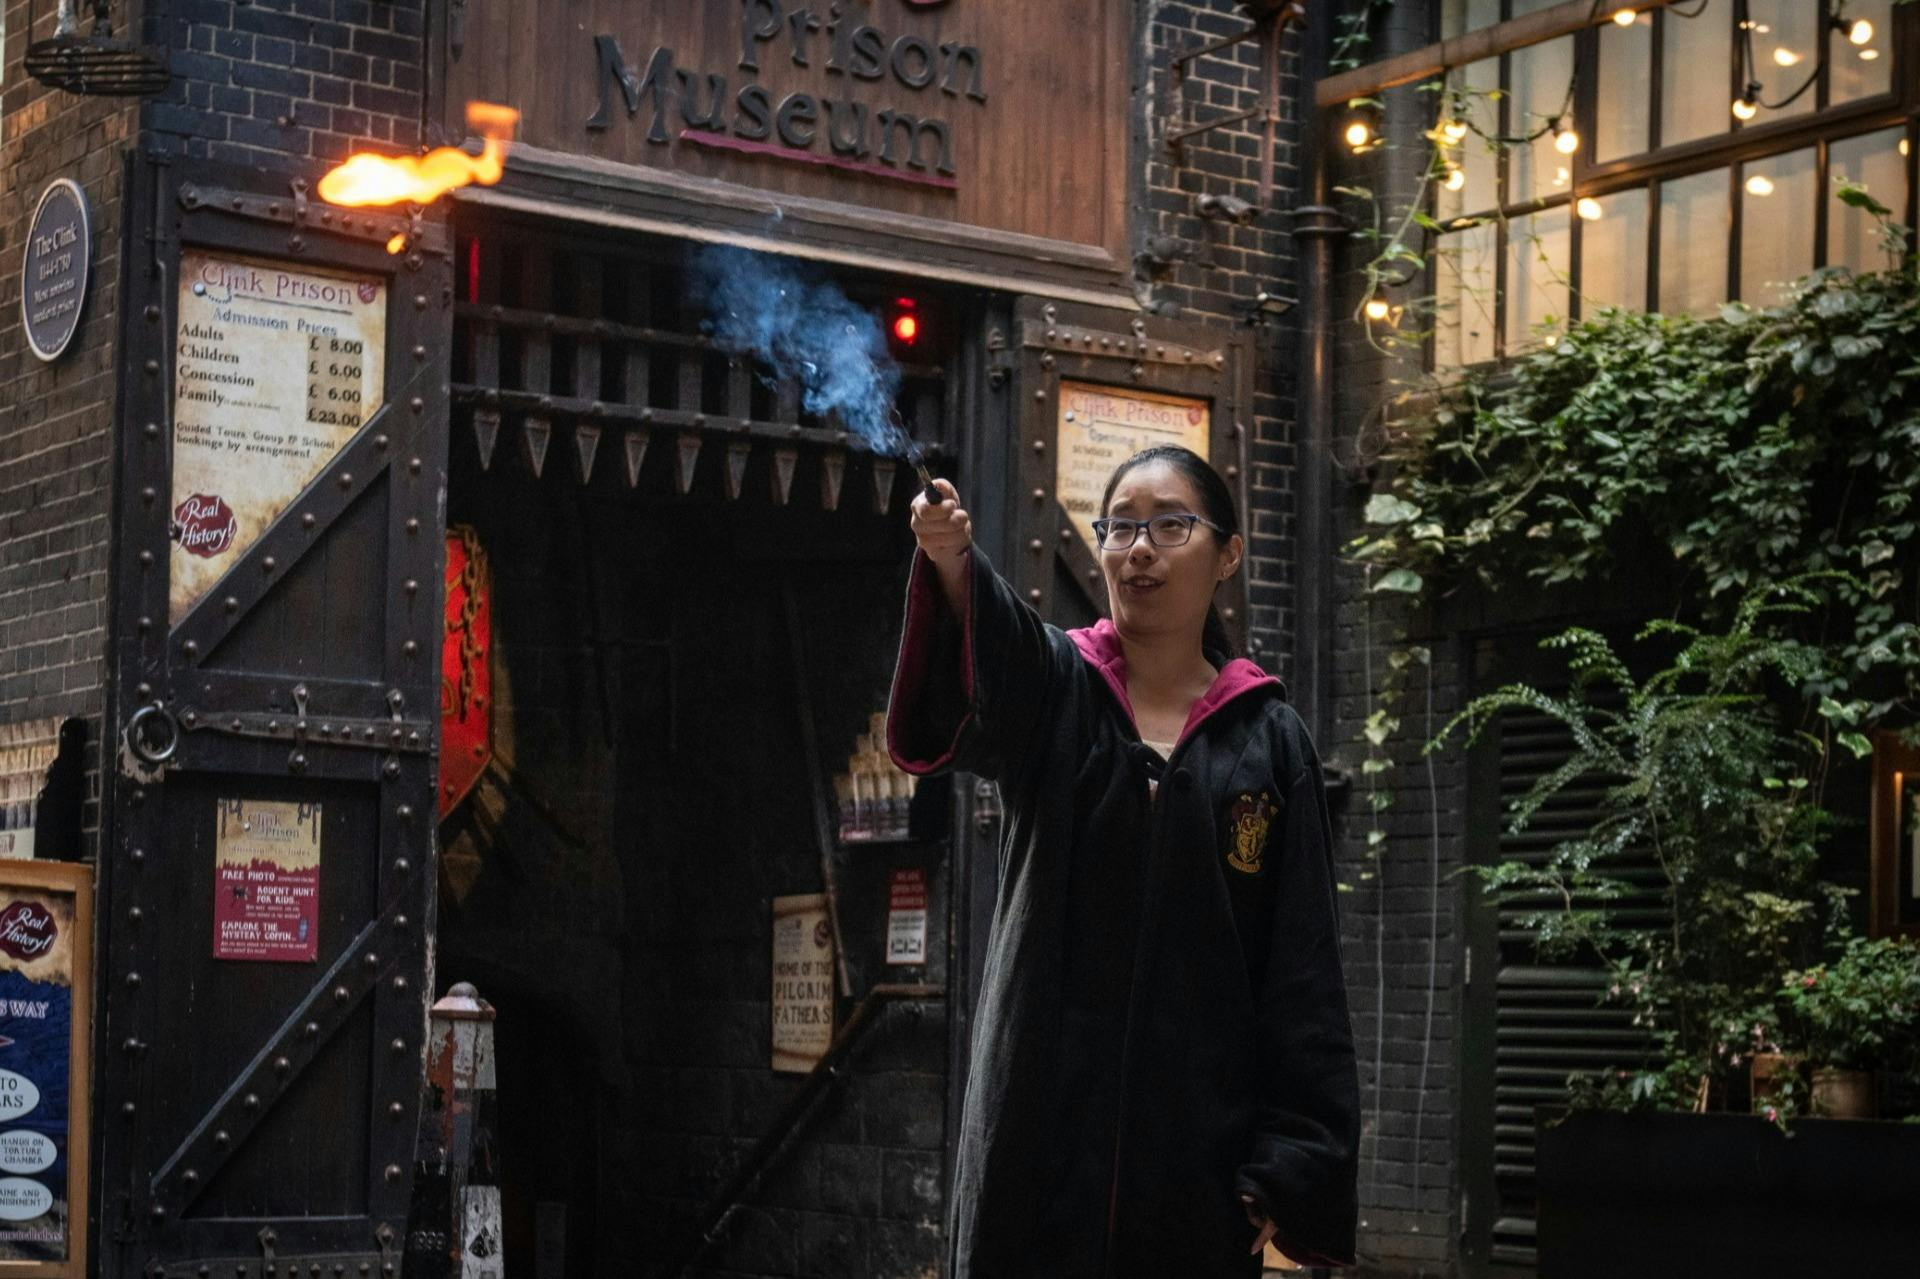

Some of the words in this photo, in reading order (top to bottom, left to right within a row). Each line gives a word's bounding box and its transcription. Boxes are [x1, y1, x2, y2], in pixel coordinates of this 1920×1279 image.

[586, 34, 955, 175] Museum
[35, 234, 53, 258] The
[53, 221, 77, 251] Clink
[202, 263, 264, 293] Clink
[275, 273, 353, 306] Prison
[212, 306, 289, 331] Admission
[297, 318, 338, 337] Prices
[179, 323, 225, 342] Adults
[308, 338, 320, 351] £
[330, 340, 363, 355] 8.00
[179, 344, 240, 364] Children
[308, 361, 320, 374] £
[329, 364, 363, 379] 6.00
[179, 364, 255, 387] Concession
[308, 384, 319, 398] £
[328, 388, 362, 402] 6.00
[178, 386, 226, 408] Family
[1071, 395, 1118, 419] Clink
[1126, 402, 1184, 427] Prison
[176, 421, 212, 434] Guided
[253, 432, 284, 445] Group
[302, 437, 336, 450] School
[176, 434, 223, 450] bookings
[227, 440, 241, 453] by
[178, 496, 221, 525] Real
[176, 518, 235, 552] History!
[222, 870, 244, 881] FREE
[248, 871, 275, 882] PHOTO
[257, 885, 290, 895] RODENT
[293, 887, 315, 897] HUNT
[12, 907, 48, 931] Real
[221, 921, 259, 931] EXPLORE
[263, 922, 278, 932] THE
[0, 921, 53, 954] History!
[221, 930, 261, 940] MYSTERY
[775, 981, 833, 1000] PILGRIM
[8, 999, 49, 1019] WAY
[774, 1005, 832, 1025] FATHERS
[4, 1147, 41, 1155] TORTURE
[4, 1156, 44, 1165] CHAMBER
[22, 1189, 40, 1198] AND
